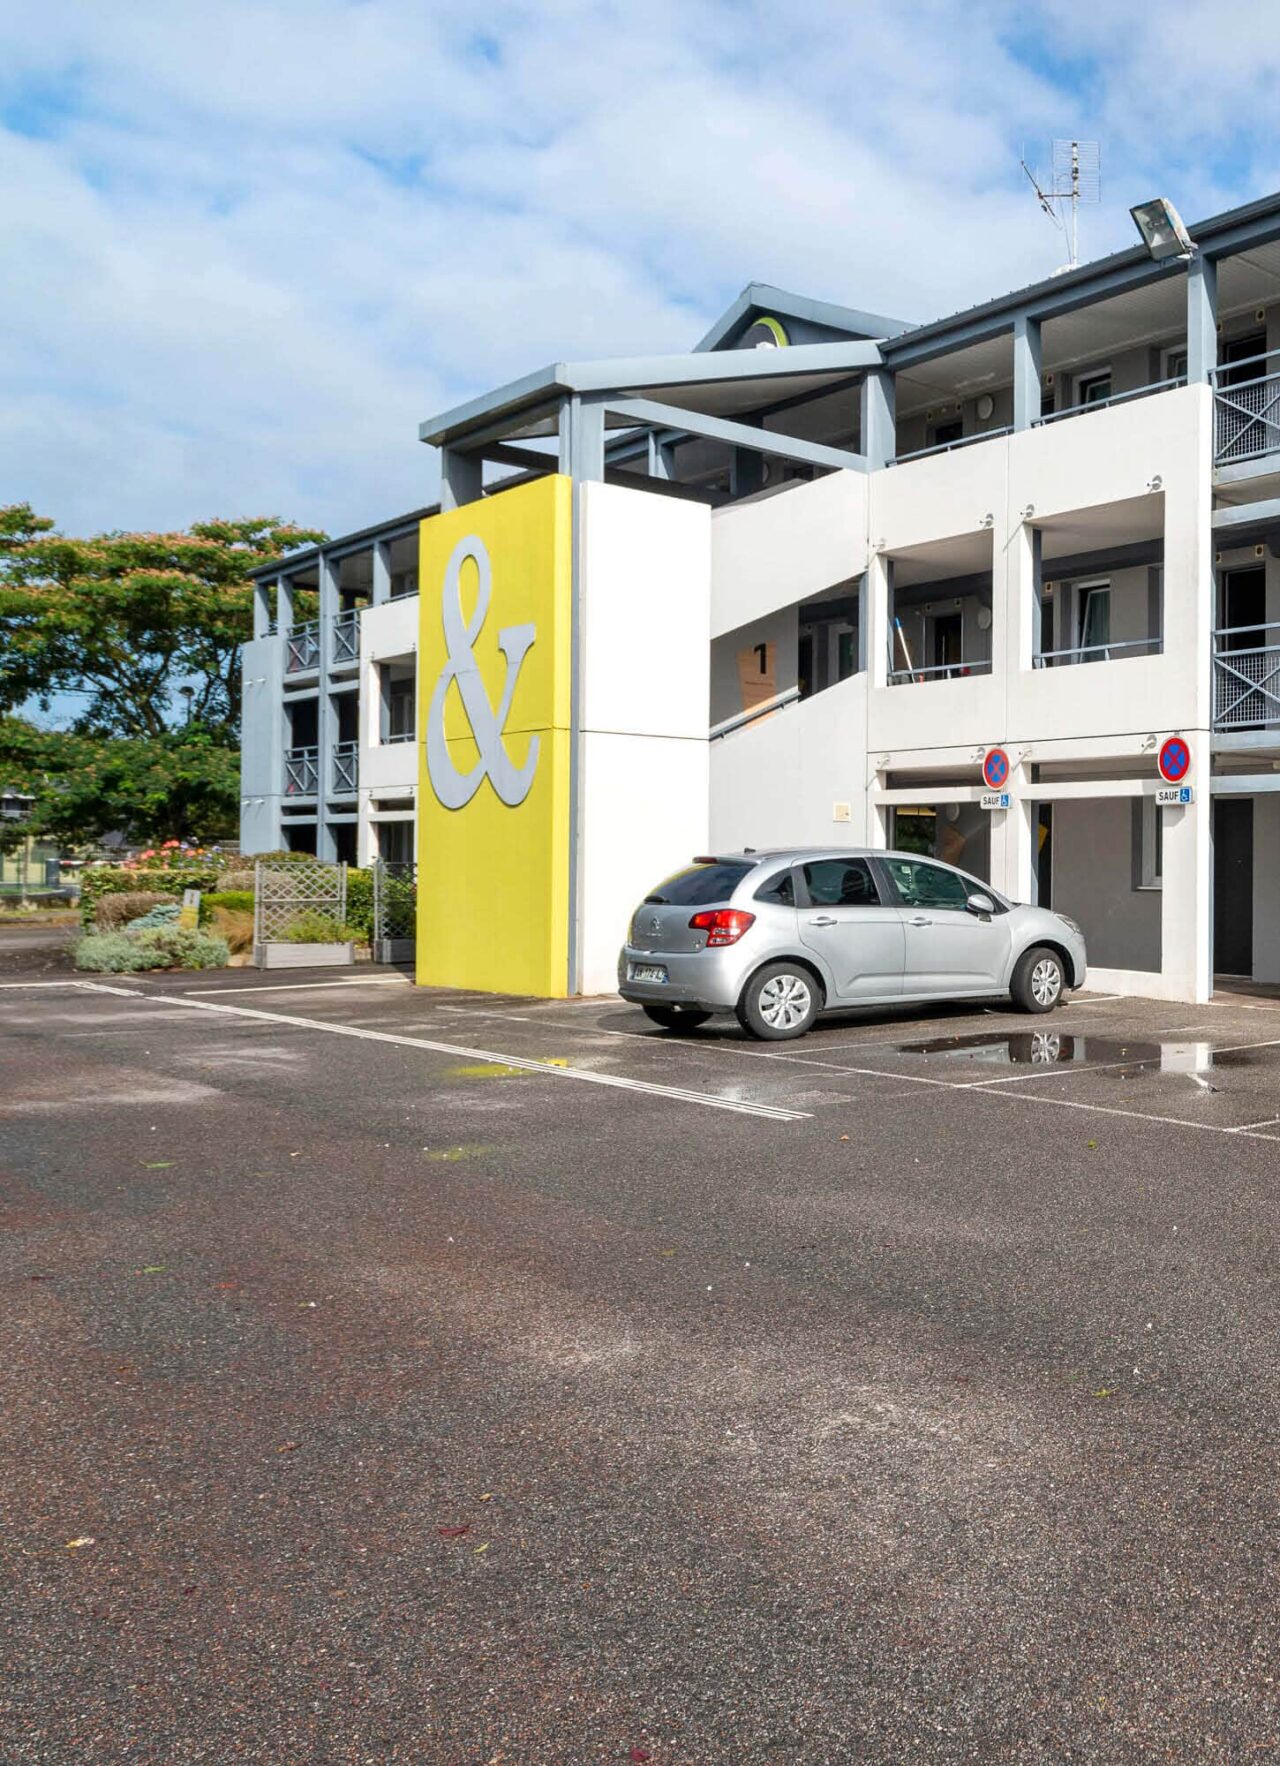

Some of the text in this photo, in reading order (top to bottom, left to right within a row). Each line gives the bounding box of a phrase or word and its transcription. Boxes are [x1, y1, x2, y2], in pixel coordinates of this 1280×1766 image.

[753, 643, 767, 675] 1
[426, 534, 541, 811] &
[983, 796, 1000, 805] SAUF
[1158, 791, 1179, 801] SAUF
